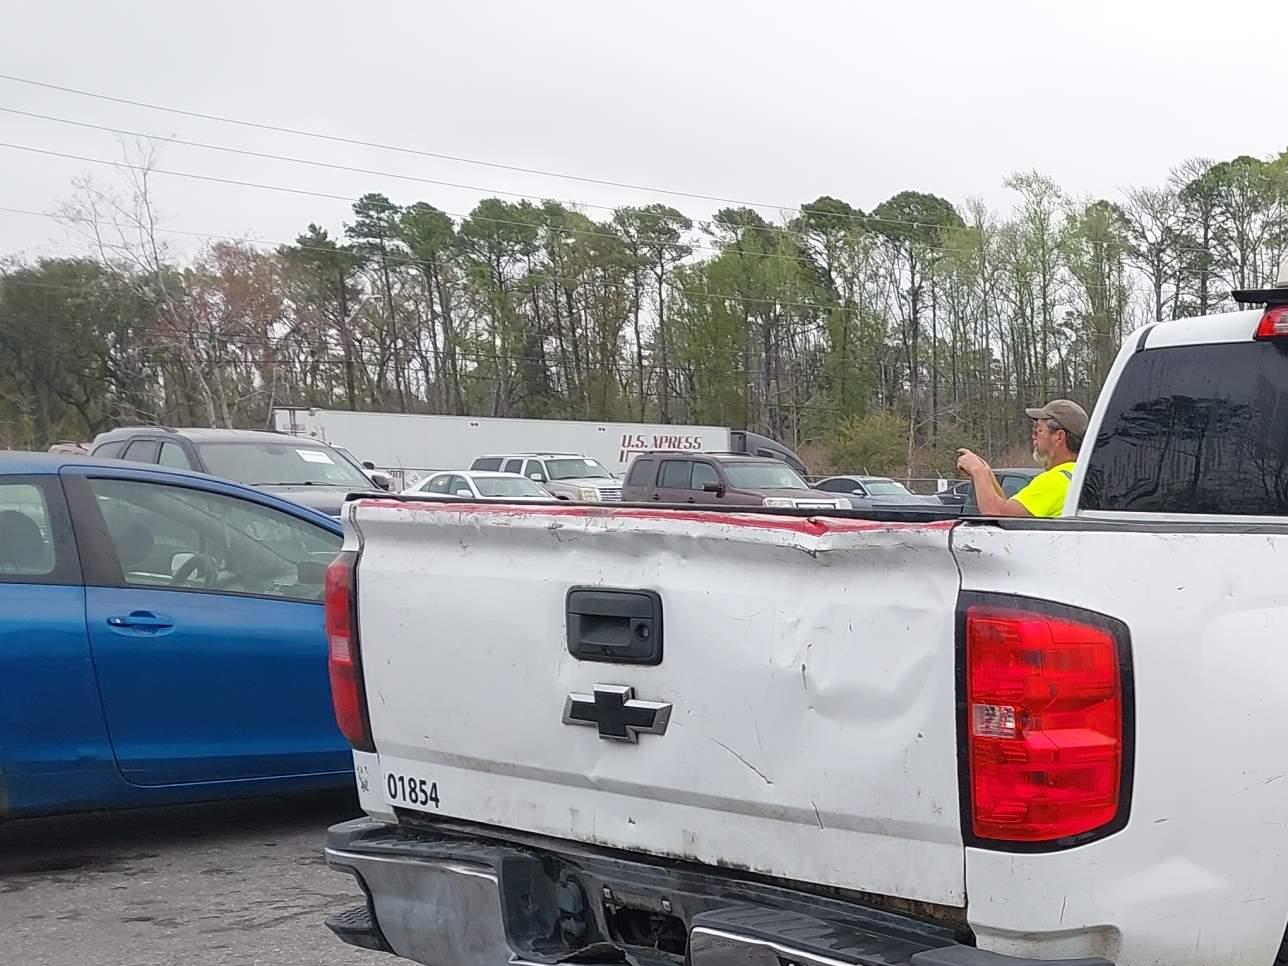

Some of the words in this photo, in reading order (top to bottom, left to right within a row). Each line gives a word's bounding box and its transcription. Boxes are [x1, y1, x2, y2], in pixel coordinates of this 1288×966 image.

[621, 433, 649, 449] U.S.
[651, 434, 704, 450] XPRESS
[386, 772, 440, 808] 01854
